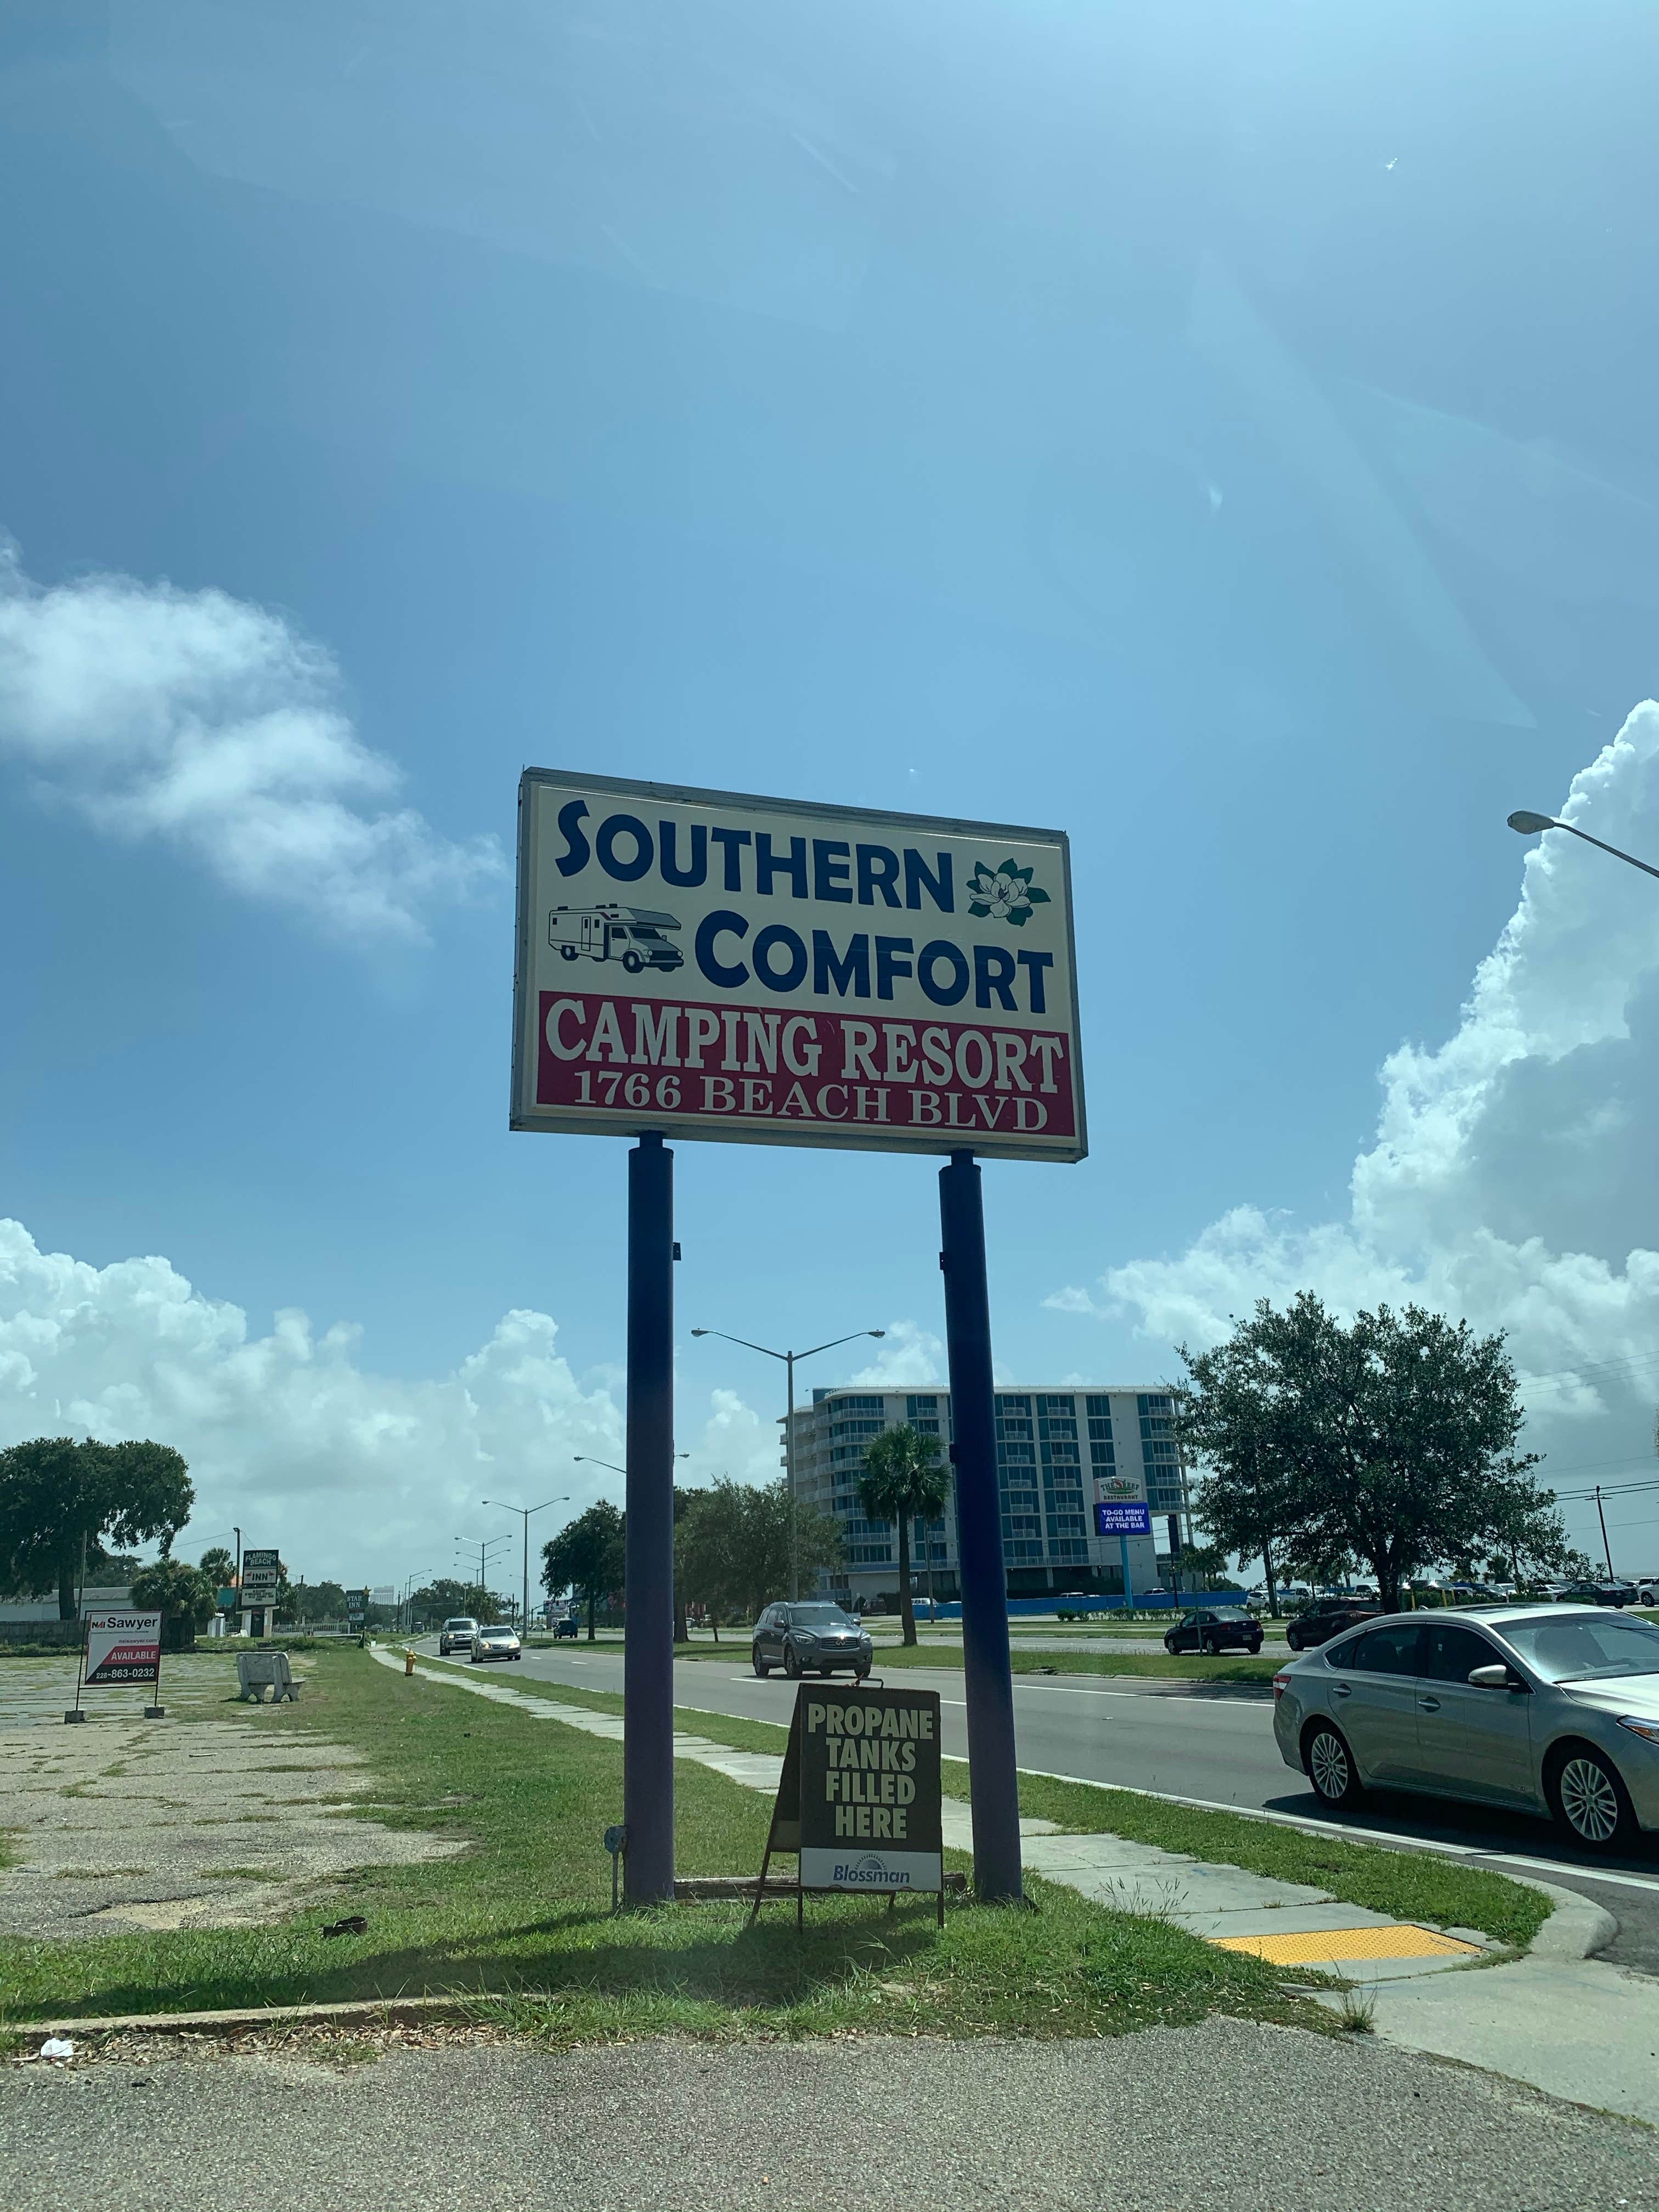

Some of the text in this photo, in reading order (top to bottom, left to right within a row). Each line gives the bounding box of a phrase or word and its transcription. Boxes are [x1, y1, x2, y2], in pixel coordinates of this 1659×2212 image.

[555, 800, 955, 913] SOUTHERN
[695, 910, 1053, 1014] COMFORT
[545, 999, 1064, 1093] CAMPING RESORT
[574, 1070, 1048, 1131] 1766 BEACH BLVD
[1101, 1482, 1114, 1491] THE
[245, 1551, 276, 1562] FLAMINGO
[107, 1617, 158, 1630] Sawyer
[111, 1651, 156, 1661] AVAILABLE
[96, 1668, 155, 1679] 228-863-0232
[808, 1703, 933, 1740] PROPANE
[826, 1737, 916, 1772] TANKS
[826, 1770, 916, 1804] FILLED
[835, 1805, 907, 1839] HERE
[833, 1864, 910, 1884] Blossman
